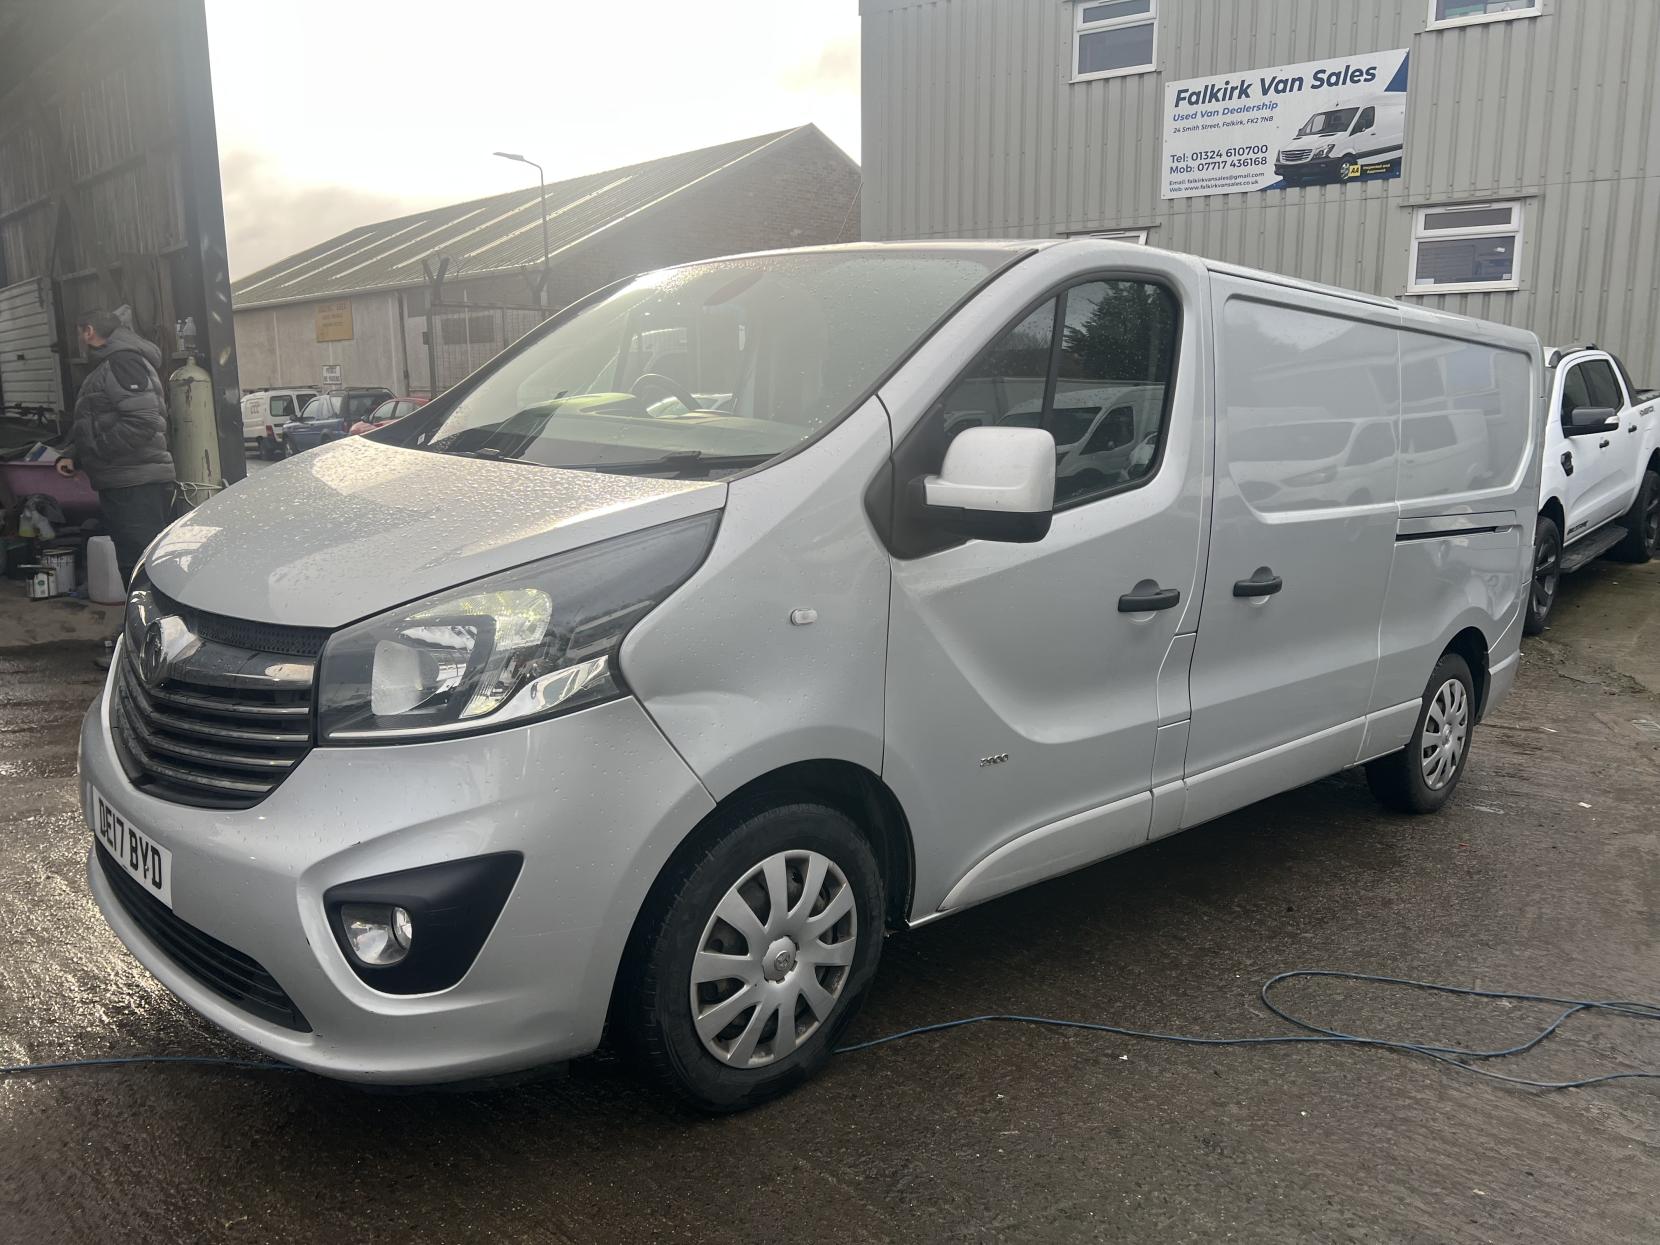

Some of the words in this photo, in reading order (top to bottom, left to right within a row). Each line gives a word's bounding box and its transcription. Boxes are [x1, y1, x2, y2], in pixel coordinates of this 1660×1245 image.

[1175, 80, 1252, 108] Falkirk
[1260, 76, 1304, 96] Van
[1311, 65, 1377, 90] Sales
[1173, 111, 1197, 122] Used
[1200, 109, 1219, 118] Van
[1222, 101, 1278, 115] Dealership
[1182, 124, 1199, 133] Smith
[1201, 122, 1221, 131] Street,
[1222, 119, 1245, 128] Falkirk,
[1247, 117, 1259, 125] FK2
[1260, 115, 1274, 123] 7NB
[1170, 153, 1189, 163] Tel:
[1191, 149, 1223, 162] 01324
[1225, 144, 1268, 158] 610700
[1169, 165, 1195, 175] Mob:
[1197, 160, 1228, 172] 07717
[1229, 156, 1268, 169] 436168
[1184, 180, 1259, 191] www.falkirkvansales.co.uk
[1187, 172, 1265, 184] falkirkvansales@gmail.com
[98, 797, 125, 859] DE17
[128, 828, 163, 890] BYD
